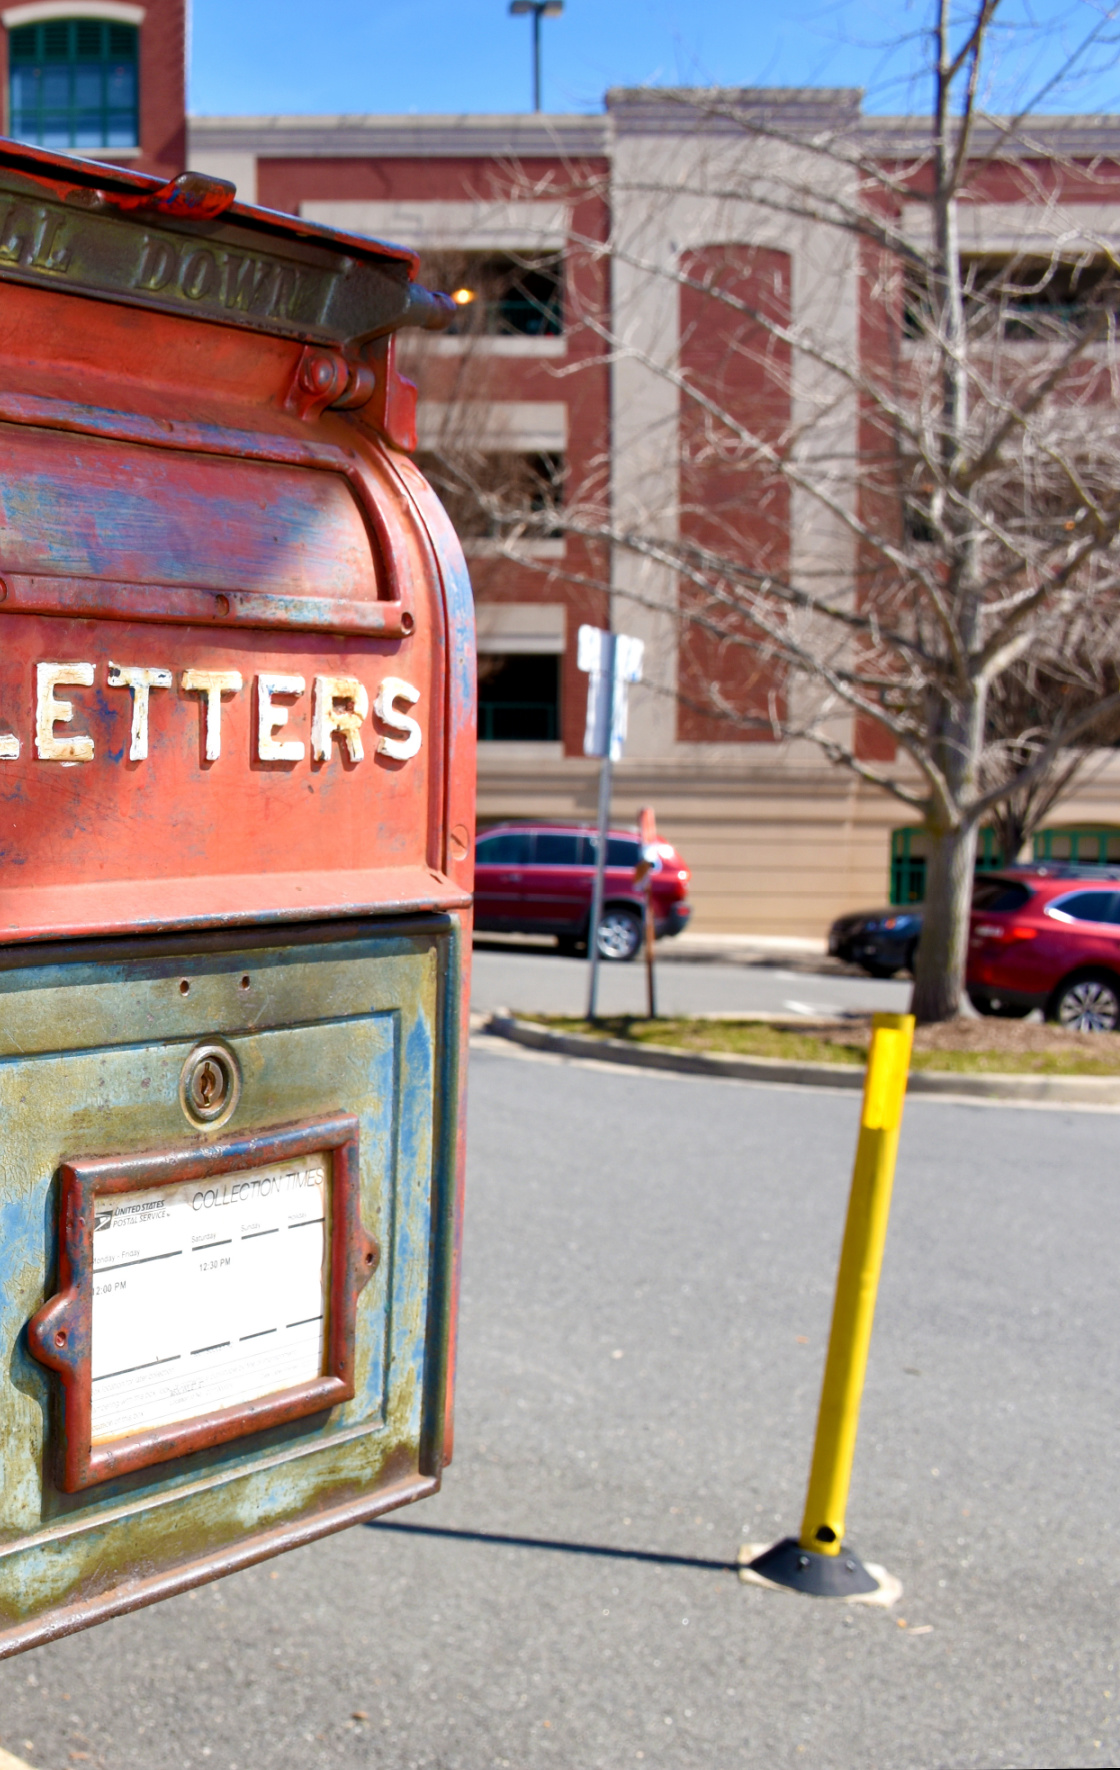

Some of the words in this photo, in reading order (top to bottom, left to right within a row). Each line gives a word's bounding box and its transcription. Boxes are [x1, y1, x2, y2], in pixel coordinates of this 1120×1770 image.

[132, 234, 309, 320] DOWN
[192, 1177, 282, 1212] COLLECTION
[284, 1166, 324, 1192] TIMES
[113, 1204, 141, 1217] UNITED
[141, 1199, 166, 1211] STATES
[112, 1217, 138, 1228] POSTAL
[139, 1210, 166, 1223] SERVICE
[191, 1232, 217, 1244] Saturday
[121, 1249, 141, 1260] Friday
[199, 1259, 219, 1272] 12:30
[220, 1256, 231, 1268] PM
[114, 1280, 127, 1291] PM
